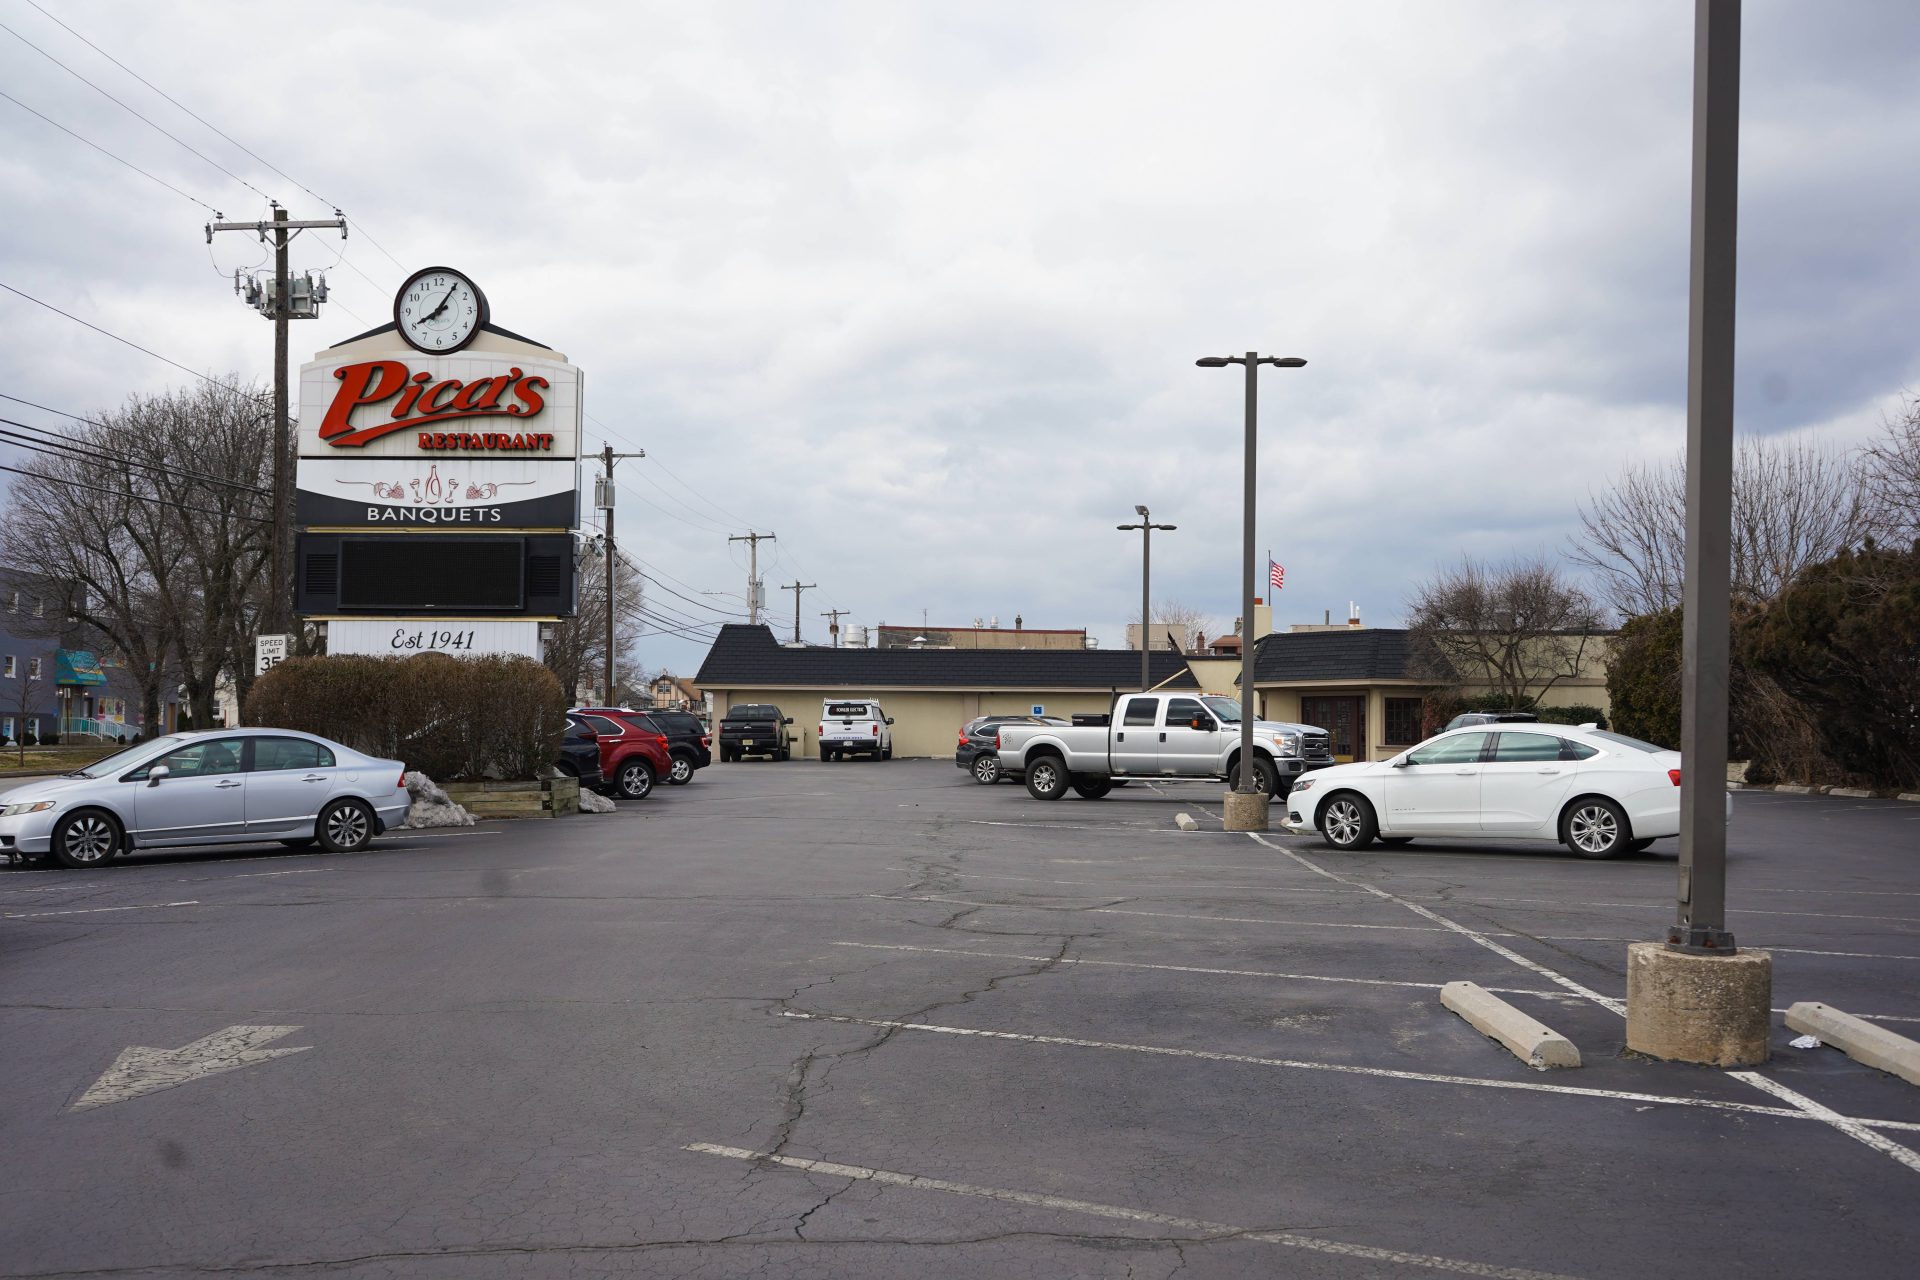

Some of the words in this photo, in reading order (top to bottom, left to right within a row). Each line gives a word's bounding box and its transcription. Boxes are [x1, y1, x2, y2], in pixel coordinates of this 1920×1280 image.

[420, 282, 430, 291] 11
[433, 277, 445, 287] 12
[409, 293, 420, 302] 10
[462, 291, 468, 301] 2
[405, 307, 411, 316] 9
[466, 306, 473, 315] 3
[411, 322, 417, 331] 8
[462, 321, 468, 330] 4
[422, 331, 428, 341] 7
[436, 336, 442, 346] 6
[451, 331, 458, 341] 5
[318, 360, 550, 446] Pica's
[418, 432, 554, 450] RESTAURANT
[367, 507, 502, 524] BANQUETS
[391, 628, 423, 649] Est
[427, 630, 475, 650] 1941
